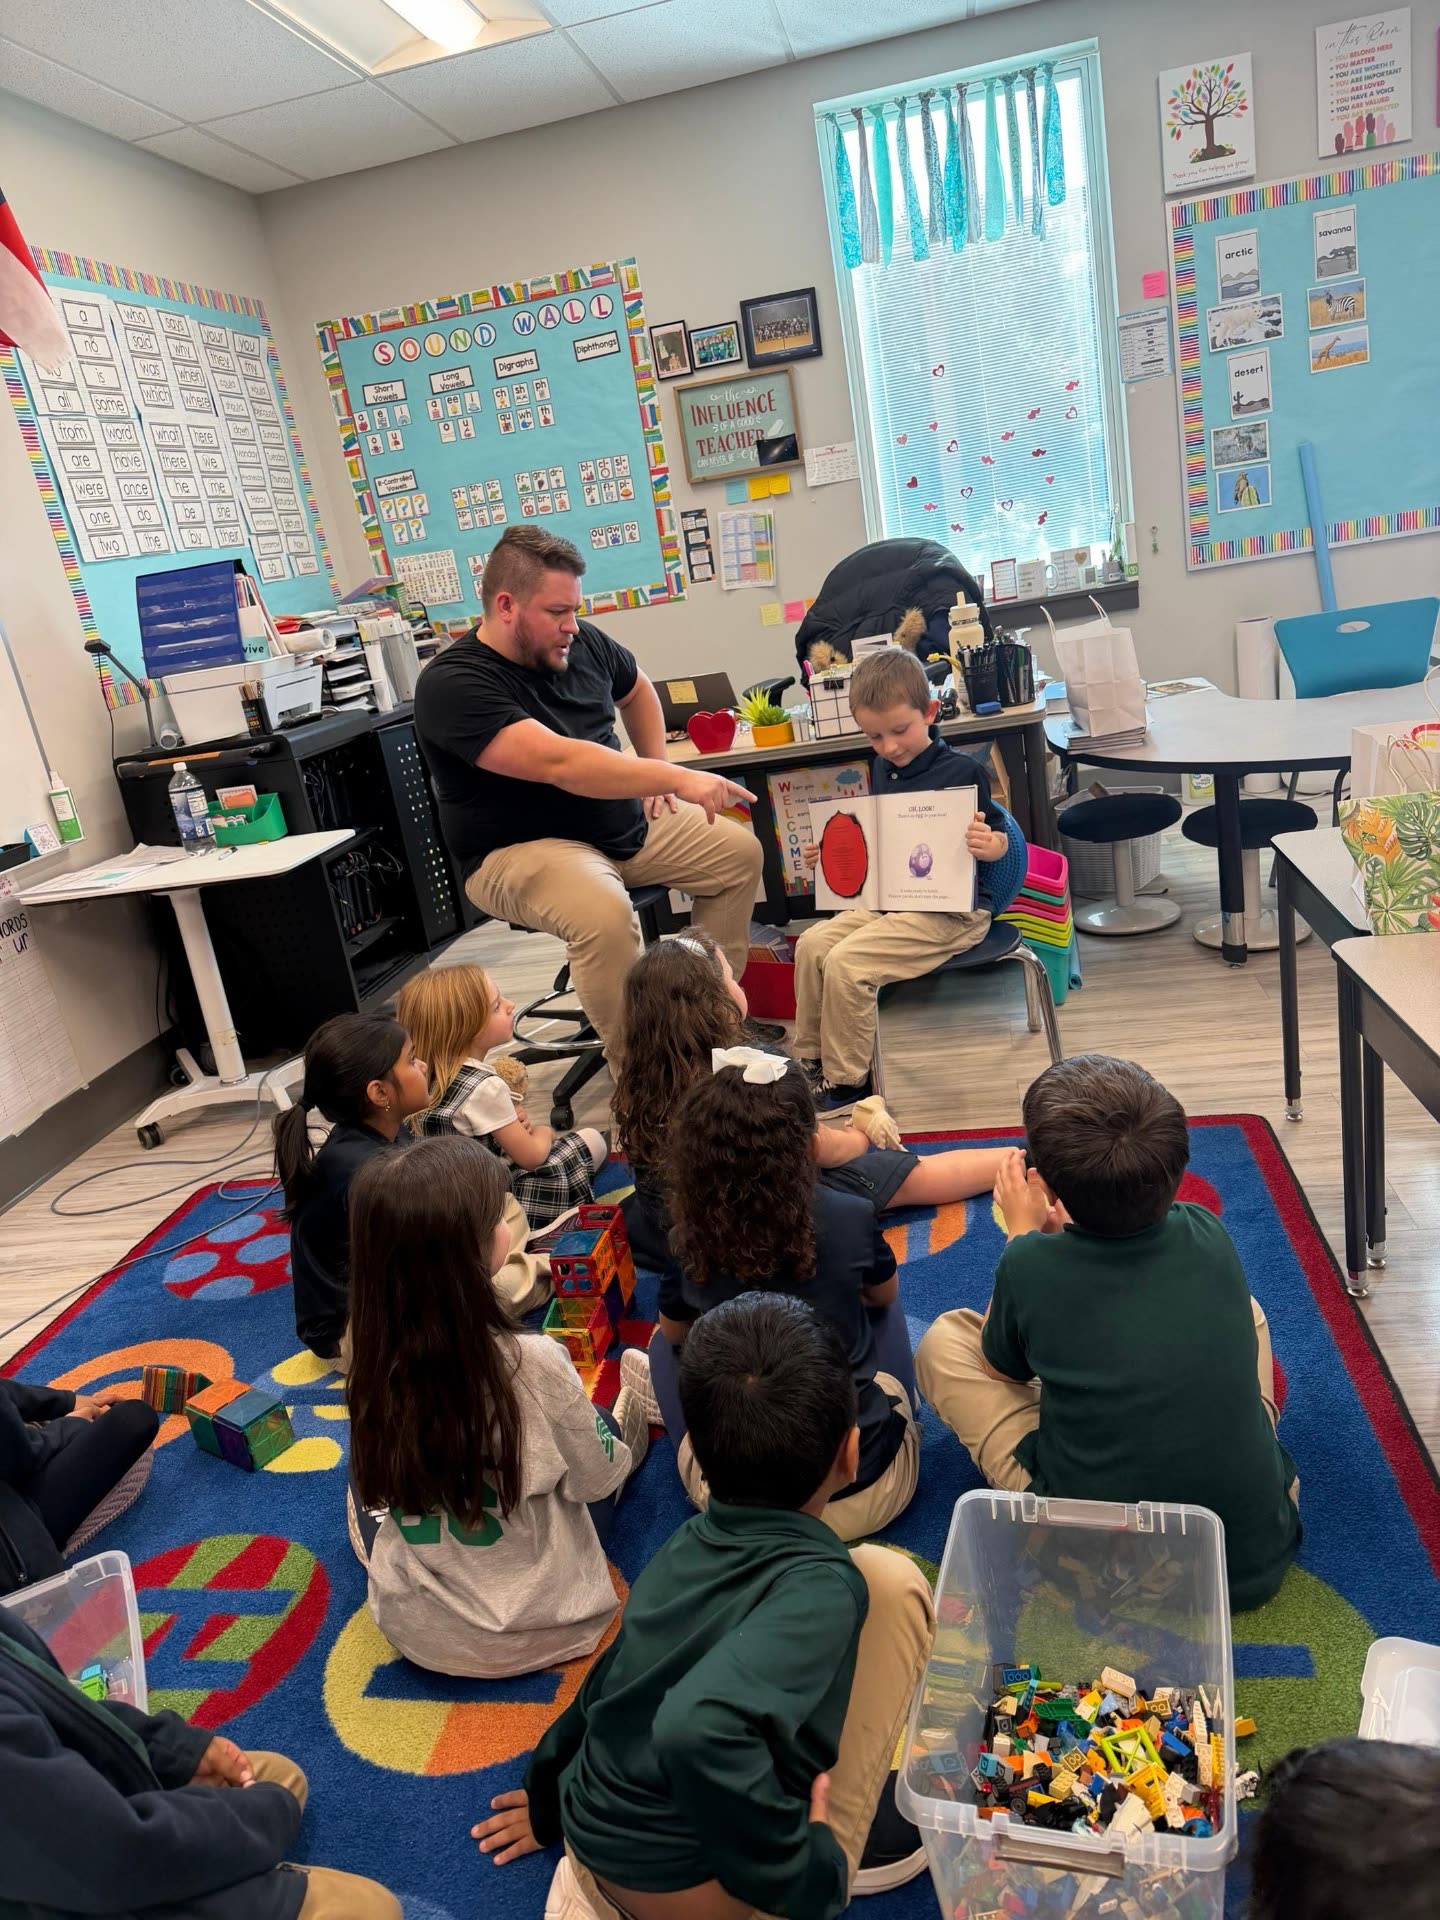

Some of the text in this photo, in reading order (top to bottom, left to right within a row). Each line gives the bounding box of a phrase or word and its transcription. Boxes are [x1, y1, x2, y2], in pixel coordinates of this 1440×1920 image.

[1350, 47, 1375, 58] BELONG
[1376, 44, 1393, 52] HERE
[1350, 56, 1375, 67] MATTER
[1335, 71, 1349, 79] YOU
[1350, 67, 1362, 75] ARE
[1364, 61, 1388, 72] WORTH
[1335, 67, 1402, 87] YOU ARE IMPORTANT
[1350, 85, 1363, 93] ARE
[1364, 80, 1385, 90] LOVED
[1336, 97, 1349, 105] YOU
[1350, 93, 1367, 101] HAVE
[1376, 86, 1395, 95] VOICE
[1336, 96, 1390, 113] YOU ARE VALUED
[1336, 113, 1349, 121] YOU
[1318, 224, 1352, 238] savanna
[1225, 247, 1254, 260] arctic
[79, 310, 88, 322] a
[124, 307, 145, 322] who
[165, 318, 184, 331] says
[378, 297, 608, 362] SOUND WALL
[133, 333, 153, 349] said
[204, 330, 223, 344] your
[173, 344, 190, 357] why
[239, 337, 255, 353] you
[576, 338, 617, 354] Diphthongs
[210, 352, 230, 368] they
[498, 358, 534, 371] Digraphs
[95, 368, 106, 383] is
[142, 363, 160, 375] was
[179, 368, 202, 382] when
[245, 362, 257, 376] my
[1234, 365, 1264, 378] desert
[442, 372, 459, 381] Long
[220, 379, 236, 389] could
[251, 384, 265, 395] would
[374, 384, 393, 394] Short
[440, 380, 465, 390] Vowels
[515, 385, 525, 394] sh
[535, 380, 546, 391] ph
[58, 391, 72, 409] all
[143, 387, 169, 402] which
[184, 393, 210, 407] where
[373, 393, 398, 403] Vowels
[495, 389, 506, 398] ch
[725, 388, 740, 402] the
[95, 398, 124, 411] some
[540, 406, 550, 415] th
[690, 389, 777, 427] INFLUENCE
[500, 412, 511, 421] qu
[519, 410, 531, 419] wh
[444, 423, 450, 431] o
[720, 416, 755, 431] OF A GOOD
[59, 422, 87, 440] from
[106, 425, 133, 440] word
[156, 427, 179, 440] what
[194, 429, 213, 443] here
[696, 429, 765, 457] TEACHER
[72, 454, 90, 467] are
[114, 451, 141, 468] have
[162, 454, 187, 468] there
[203, 457, 217, 468] we
[598, 460, 609, 468] cl-
[615, 458, 626, 466] sl-
[697, 459, 709, 468] CAN
[550, 469, 562, 477] dr-
[581, 464, 591, 472] bl-
[378, 474, 412, 486] R-Controlled
[517, 475, 528, 483] fr-
[533, 471, 545, 480] gr-
[76, 483, 104, 496] were
[124, 483, 148, 495] once
[174, 478, 189, 492] he
[210, 481, 225, 494] me
[387, 483, 407, 492] Vowels
[486, 482, 499, 490] sc-
[585, 486, 596, 495] gl-
[603, 484, 614, 492] fl-
[620, 480, 630, 489] pl-
[452, 489, 465, 499] st-
[521, 496, 534, 505] pr-
[538, 494, 549, 502] br-
[90, 511, 111, 524] one
[137, 506, 151, 521] do
[183, 503, 196, 519] be
[217, 504, 230, 518] she
[457, 510, 470, 518] sp-
[591, 528, 604, 537] ou
[606, 525, 620, 534] aw
[625, 523, 636, 531] oo
[145, 533, 161, 547] the
[189, 529, 202, 544] by
[220, 528, 238, 542] their
[100, 538, 120, 552] two
[268, 561, 277, 574] so
[12, 932, 28, 953] ur
